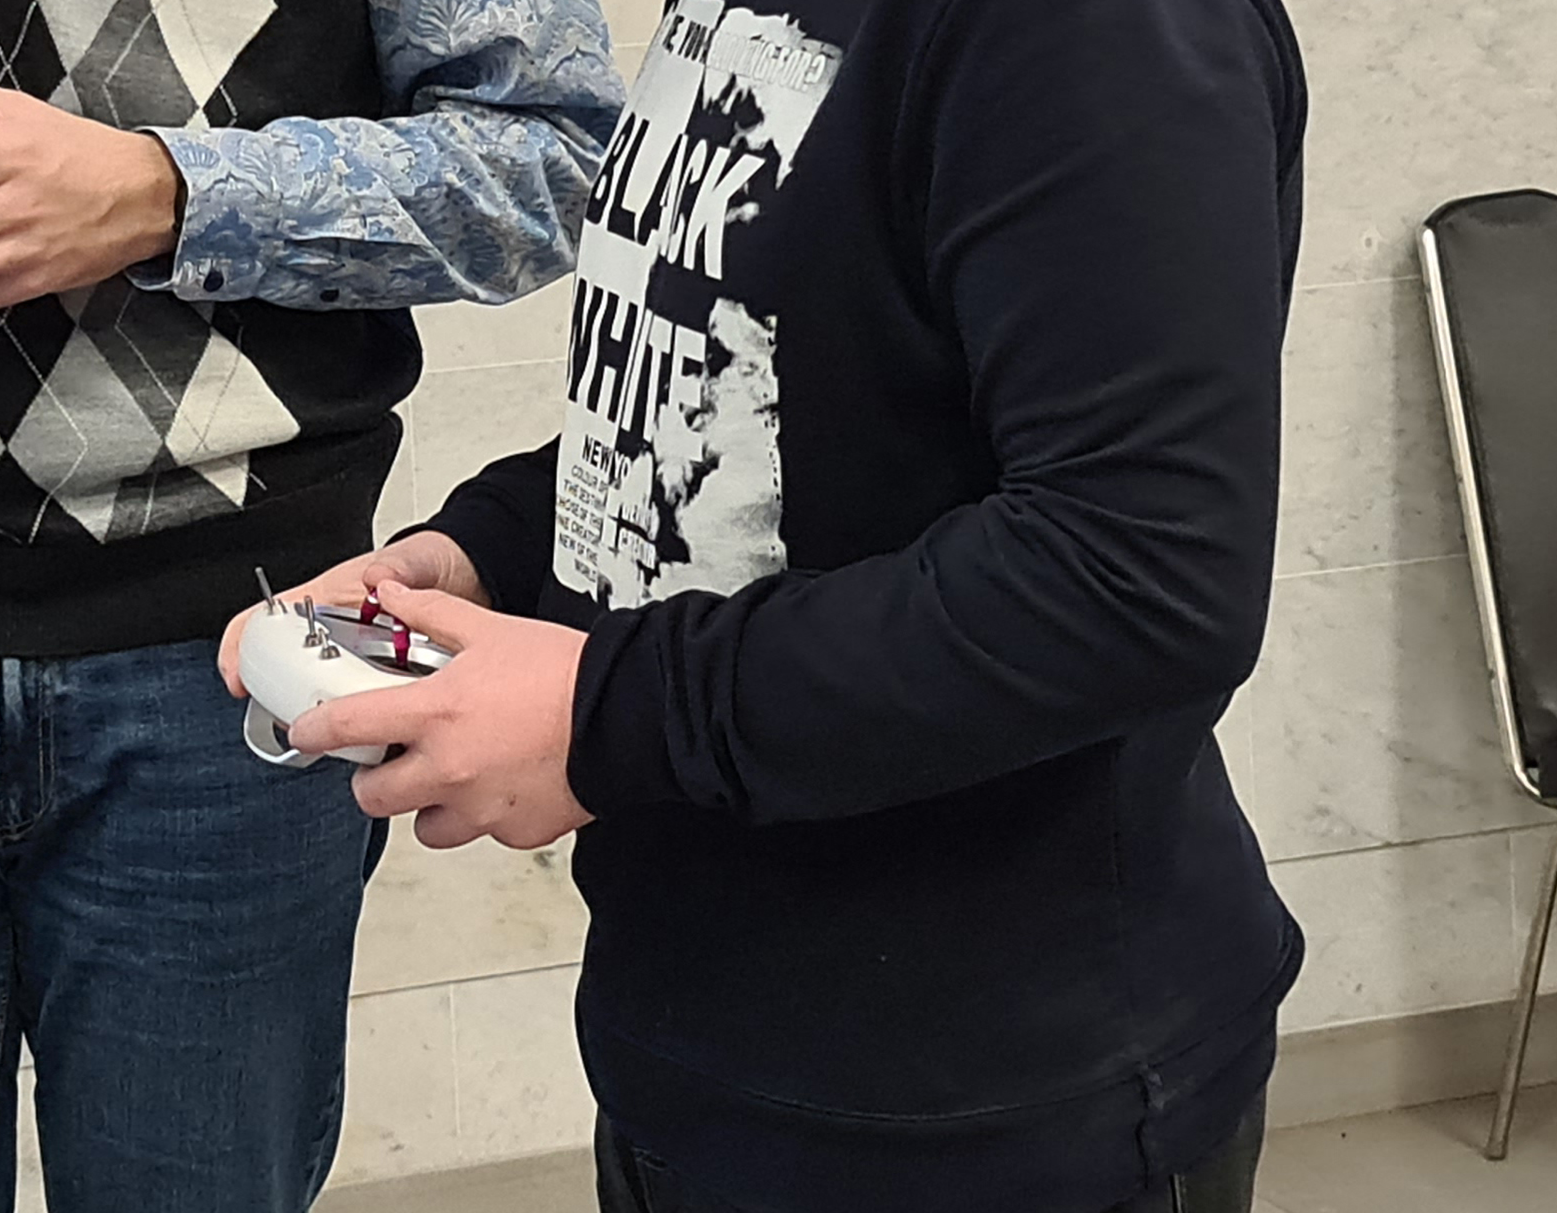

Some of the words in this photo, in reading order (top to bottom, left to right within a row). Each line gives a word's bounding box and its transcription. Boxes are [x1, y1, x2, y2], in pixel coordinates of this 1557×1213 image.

[585, 112, 766, 280] BLACK
[567, 278, 706, 456] WHITE
[582, 434, 613, 474] NEW
